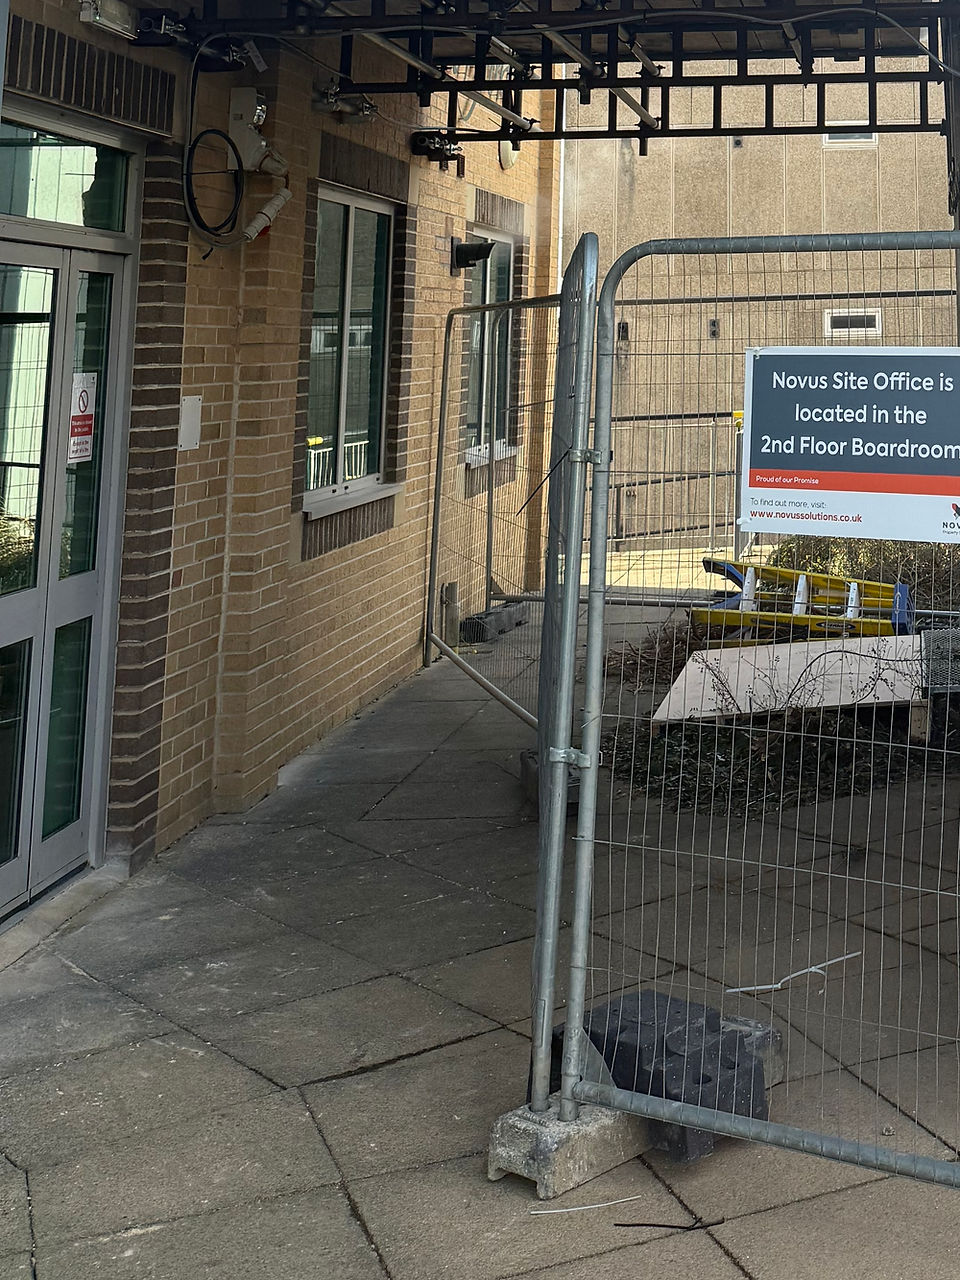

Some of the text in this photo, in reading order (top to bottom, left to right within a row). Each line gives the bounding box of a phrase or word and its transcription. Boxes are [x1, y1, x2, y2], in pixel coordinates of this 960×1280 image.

[772, 371, 954, 392] Novus Site Office is
[795, 403, 927, 425] located in the
[760, 435, 795, 454] 2nd
[800, 436, 847, 456] Floor
[755, 475, 775, 483] Proud
[794, 476, 819, 485] Promise
[750, 497, 759, 505] To
[760, 498, 774, 507] find
[775, 499, 787, 507] out
[788, 500, 810, 509] more,
[750, 510, 862, 523] www.novussolutions.co.uk
